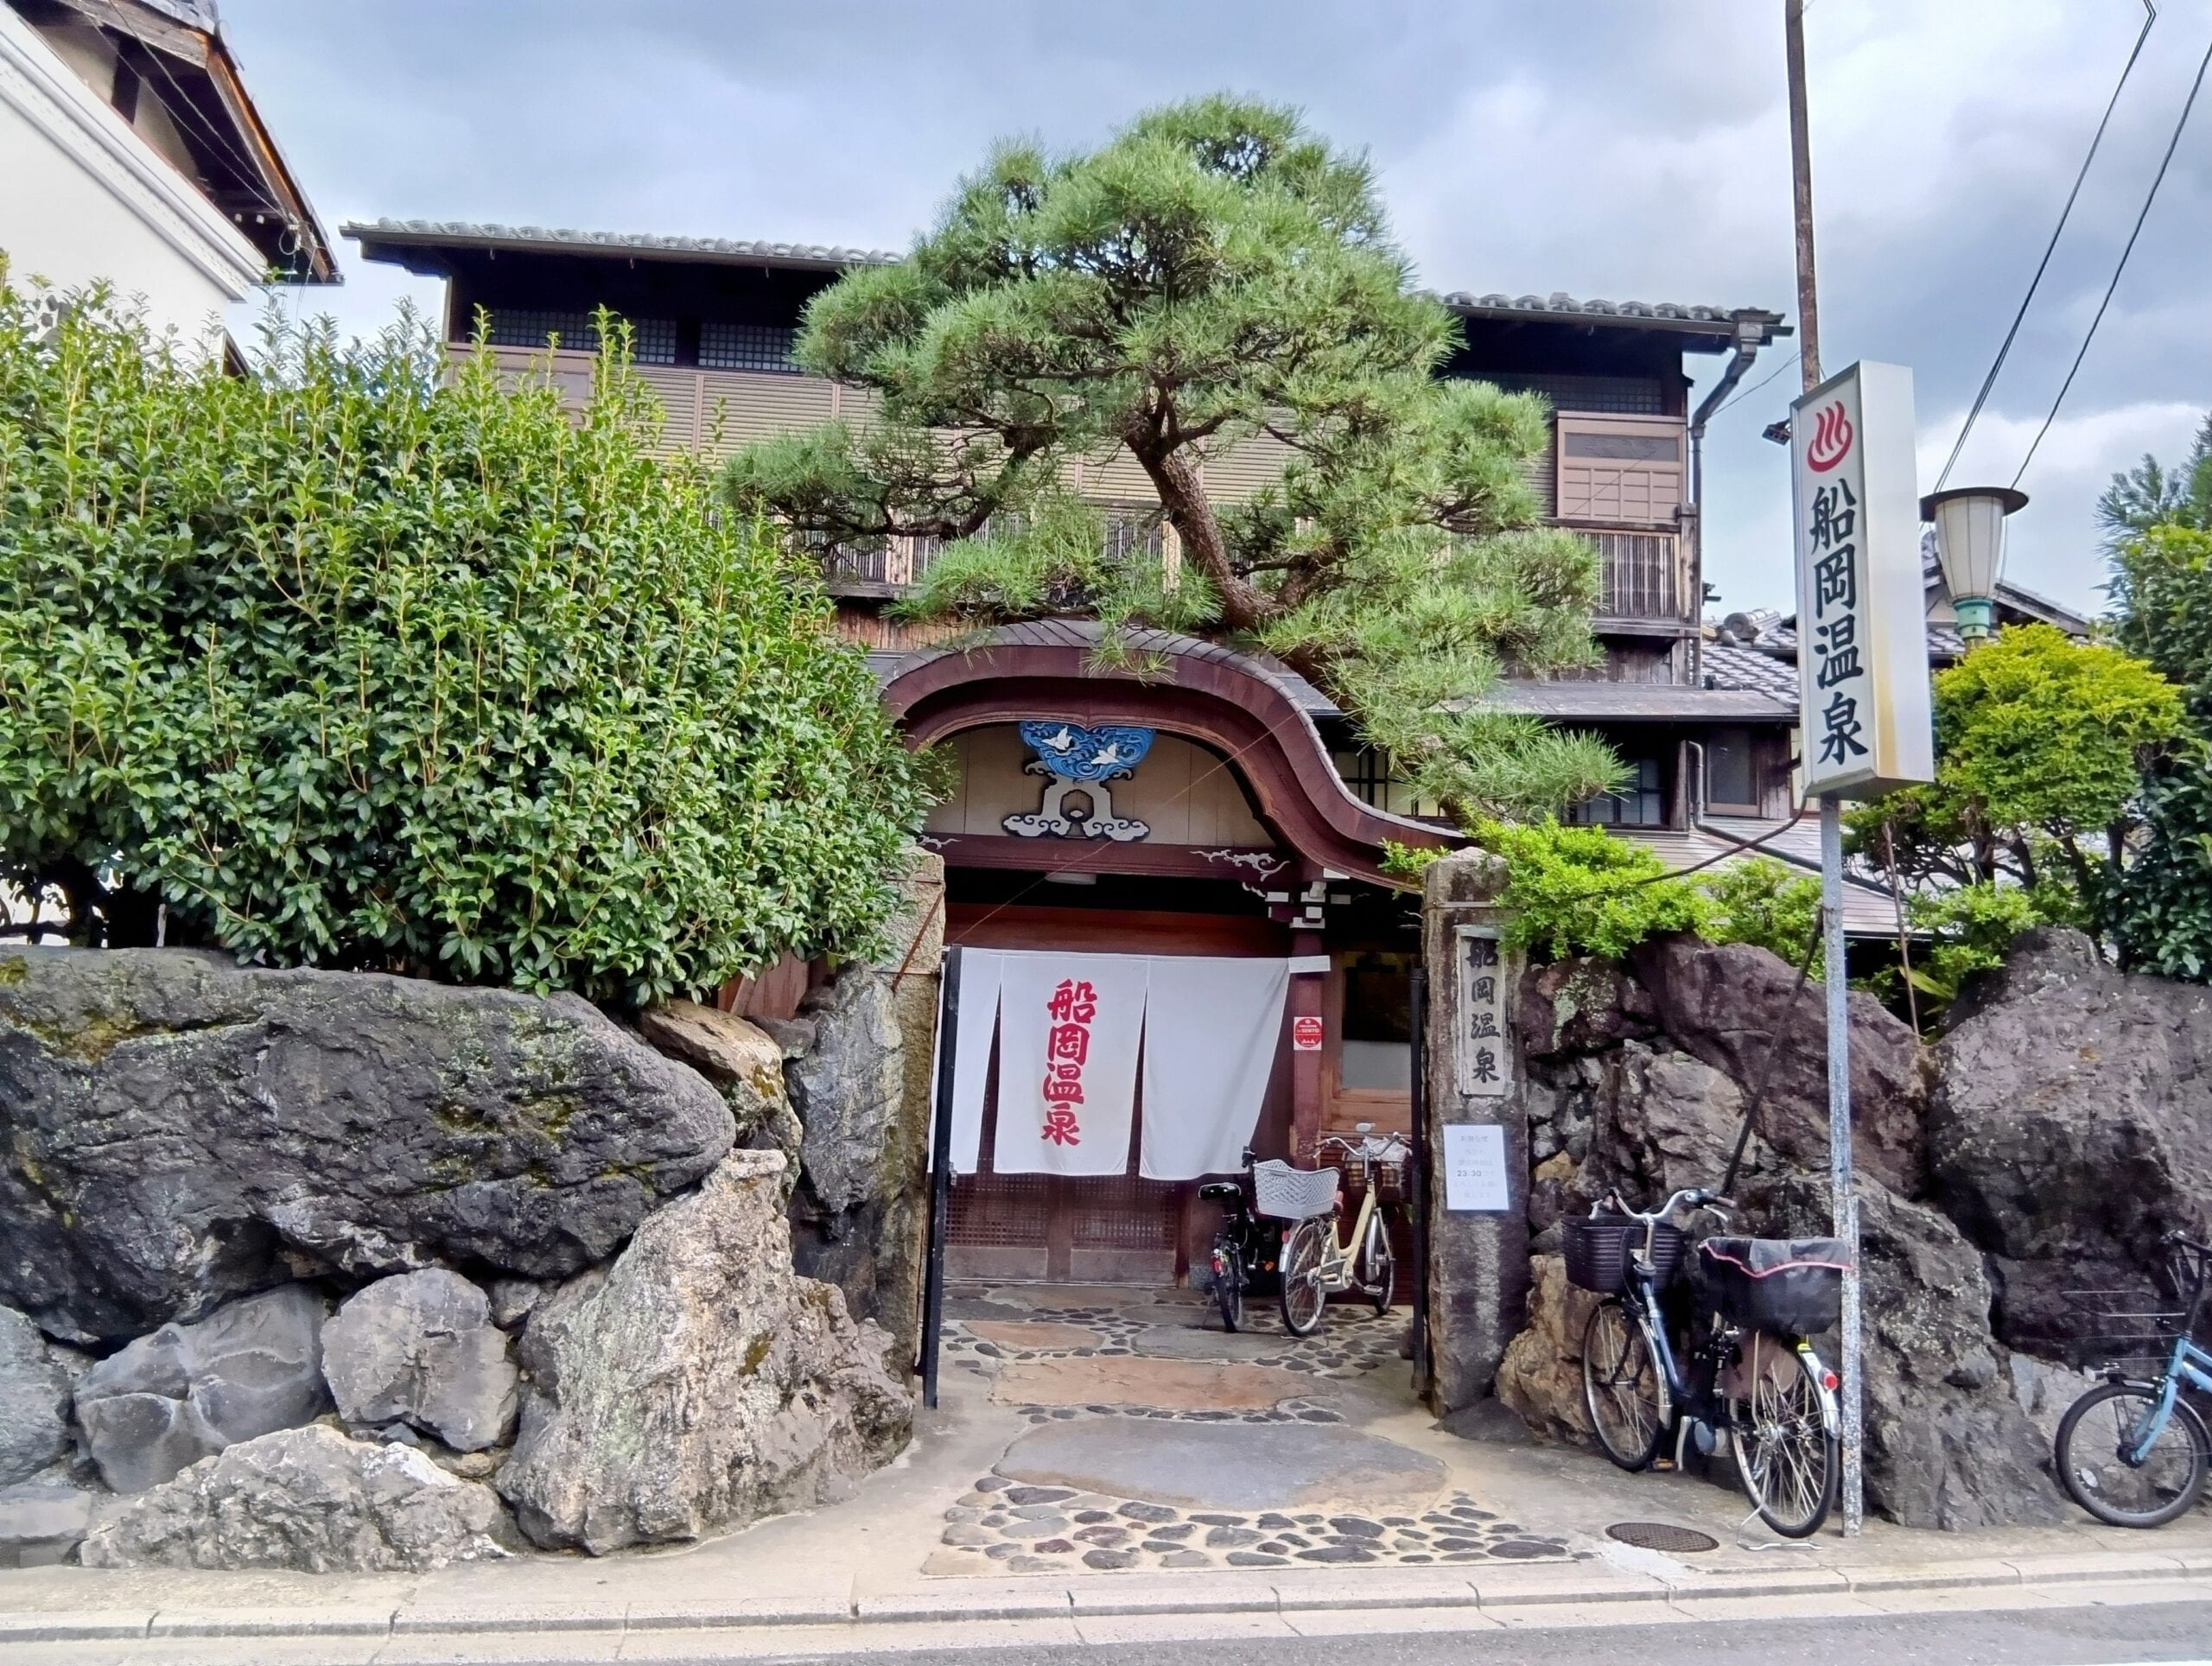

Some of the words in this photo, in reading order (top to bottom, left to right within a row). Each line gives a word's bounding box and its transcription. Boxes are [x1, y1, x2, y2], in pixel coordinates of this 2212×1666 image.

[1809, 477, 1868, 766] 船岡温泉
[1039, 978, 1098, 1147] 船岡温泉
[1465, 938, 1501, 1084] 船岡温泉
